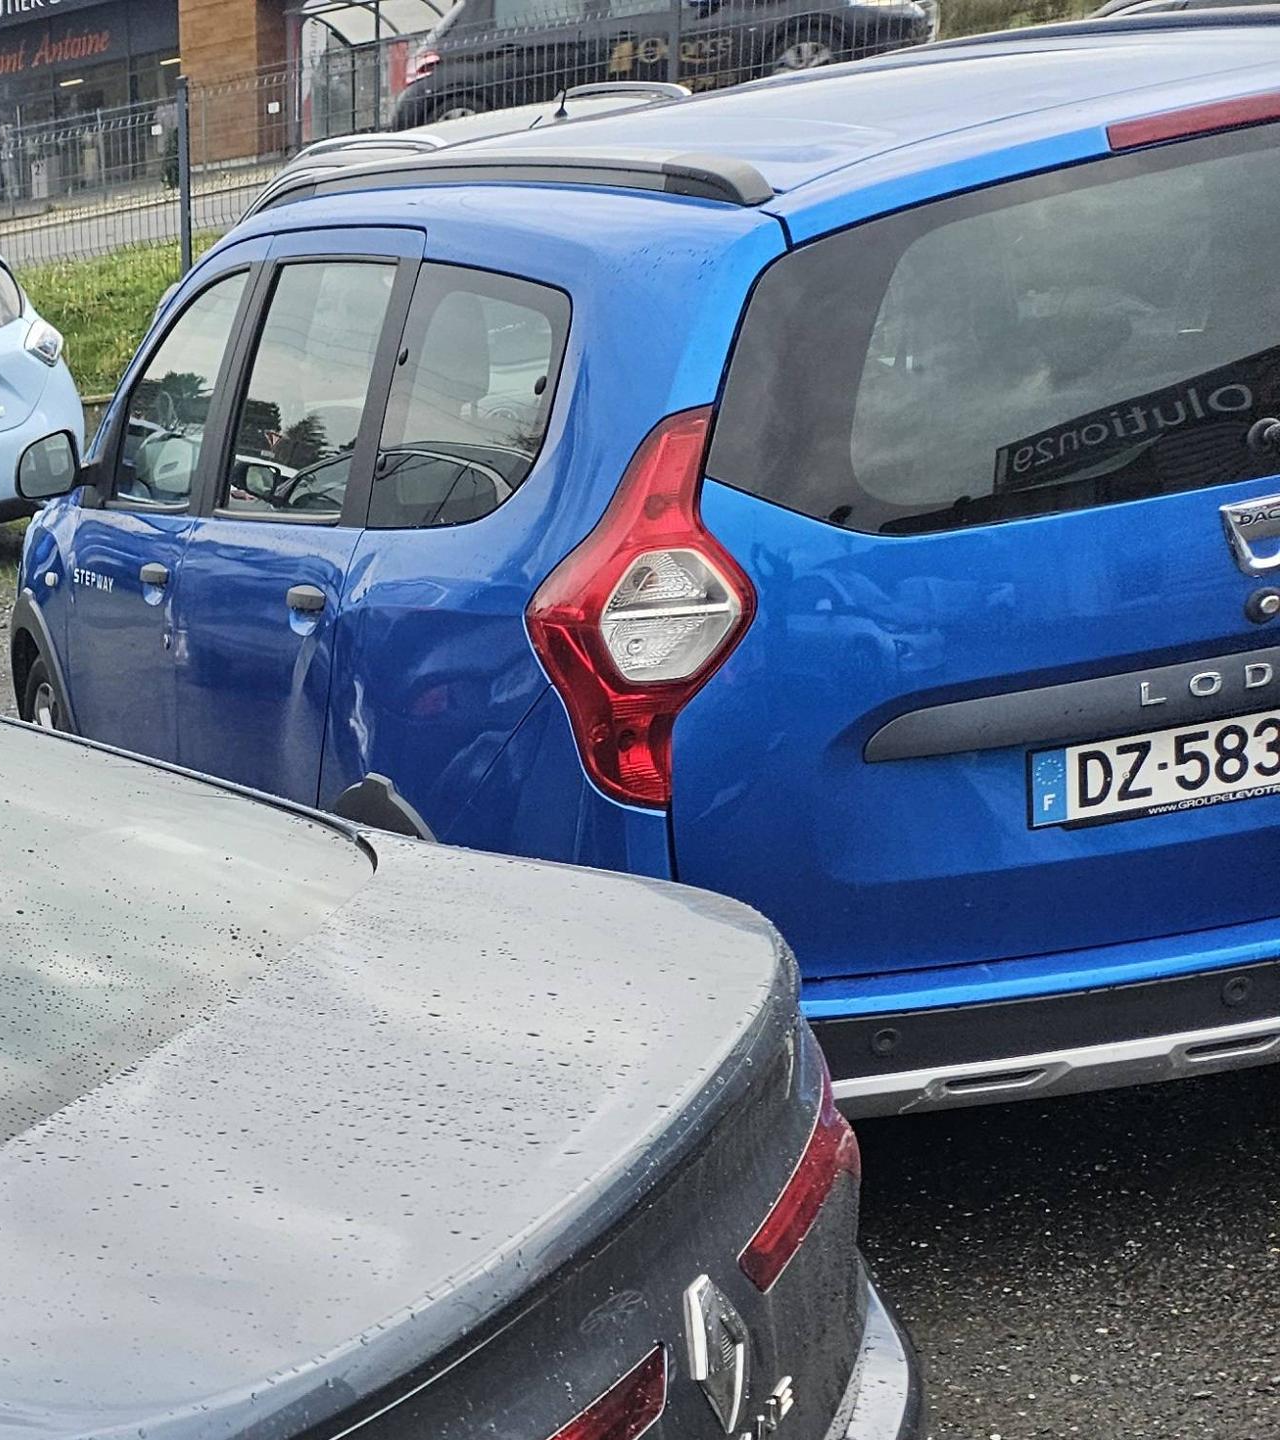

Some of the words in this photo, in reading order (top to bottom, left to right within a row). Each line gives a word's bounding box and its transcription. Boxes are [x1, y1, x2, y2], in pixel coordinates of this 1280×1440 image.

[30, 28, 112, 69] Antoine
[73, 567, 115, 594] STEPWAY
[1140, 662, 1273, 707] LOD
[1077, 717, 1280, 809] DZ-583
